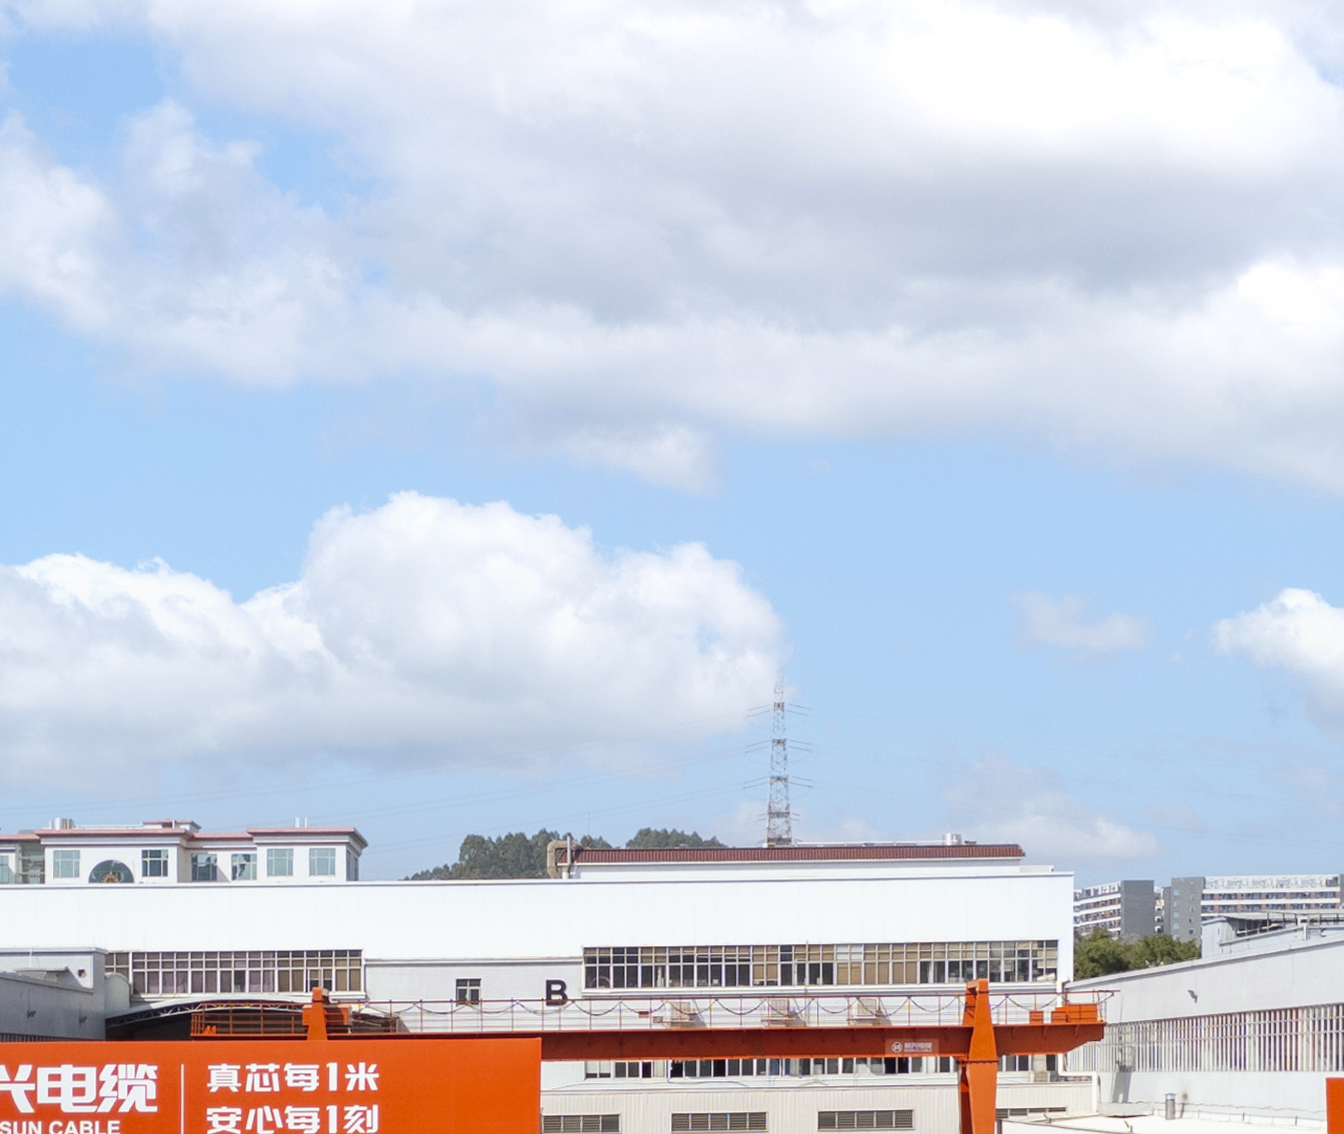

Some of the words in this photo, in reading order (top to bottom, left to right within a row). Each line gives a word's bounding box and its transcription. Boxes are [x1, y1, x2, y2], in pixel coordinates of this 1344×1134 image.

[545, 979, 568, 1006] B
[206, 1061, 380, 1093] 真芯每1米
